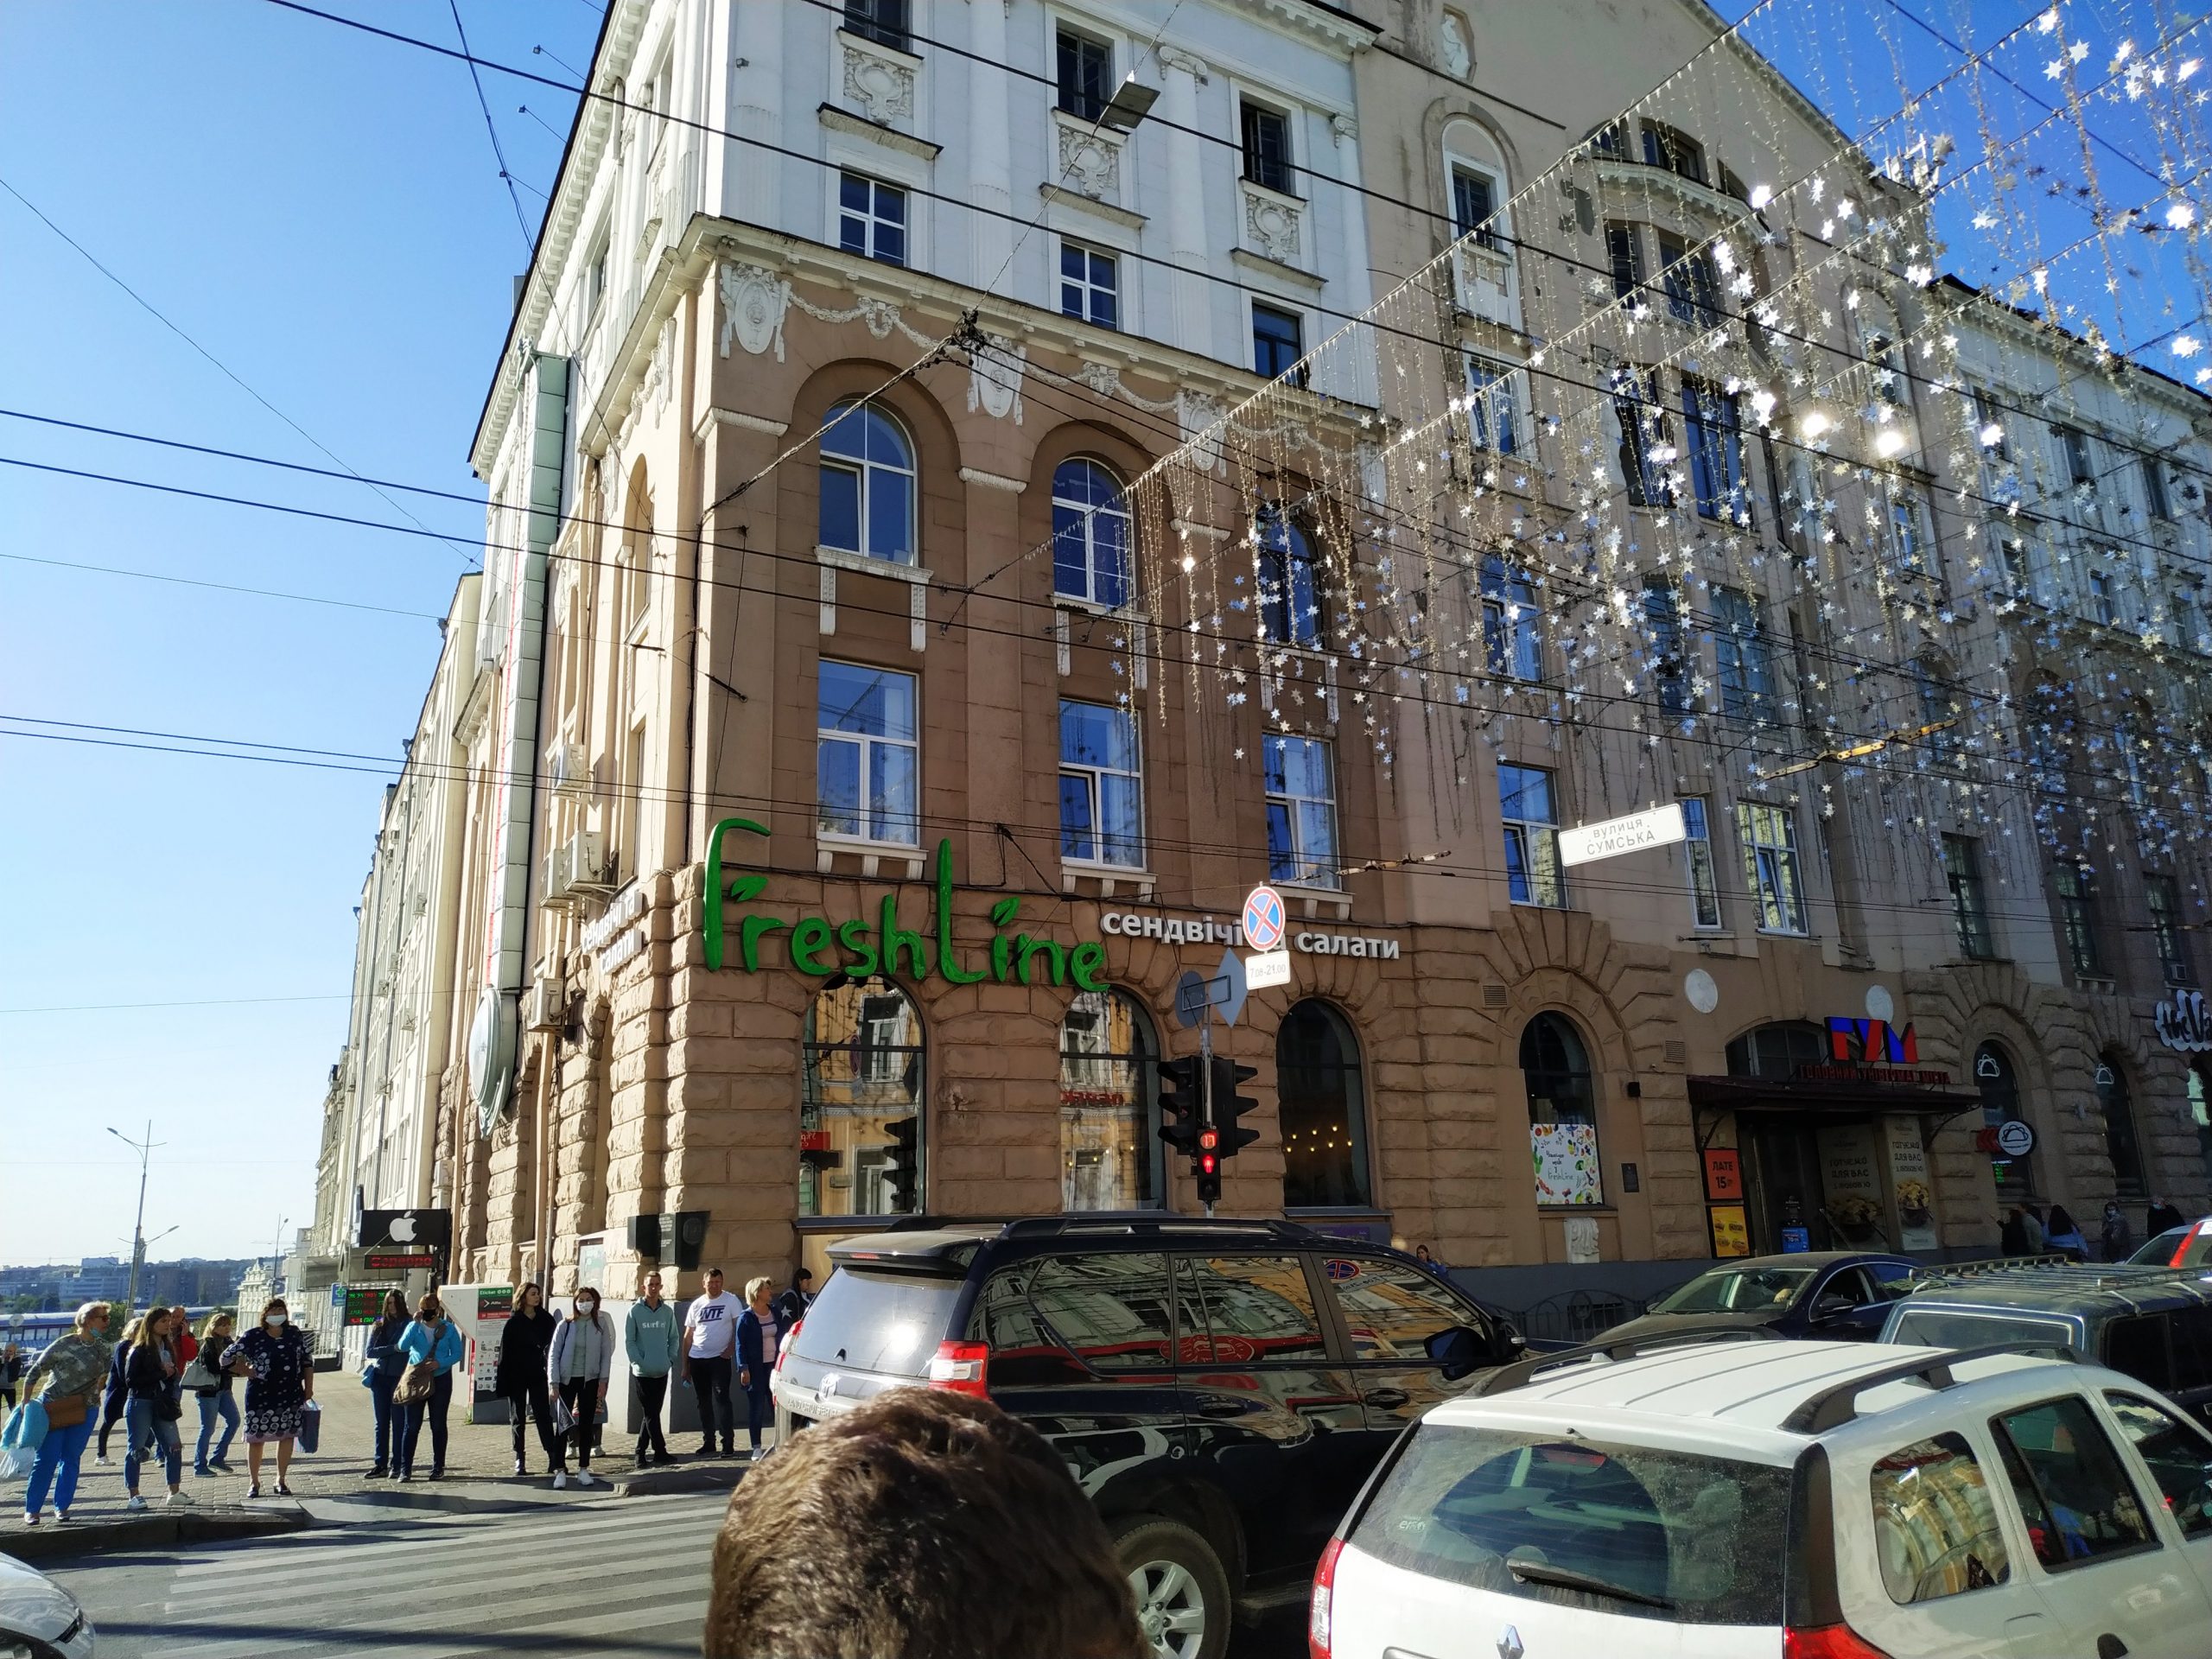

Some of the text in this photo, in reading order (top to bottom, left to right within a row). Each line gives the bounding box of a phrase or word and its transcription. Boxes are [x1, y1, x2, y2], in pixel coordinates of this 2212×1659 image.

[1593, 818, 1643, 839] вулиця
[1586, 830, 1655, 855] СУМСЬКА
[1100, 911, 1243, 947] сендвічі
[1294, 931, 1401, 960] салати
[1825, 1016, 1919, 1064] ГУМ
[1712, 1160, 1734, 1172] ЛАТЕ
[1715, 1176, 1727, 1189] 15
